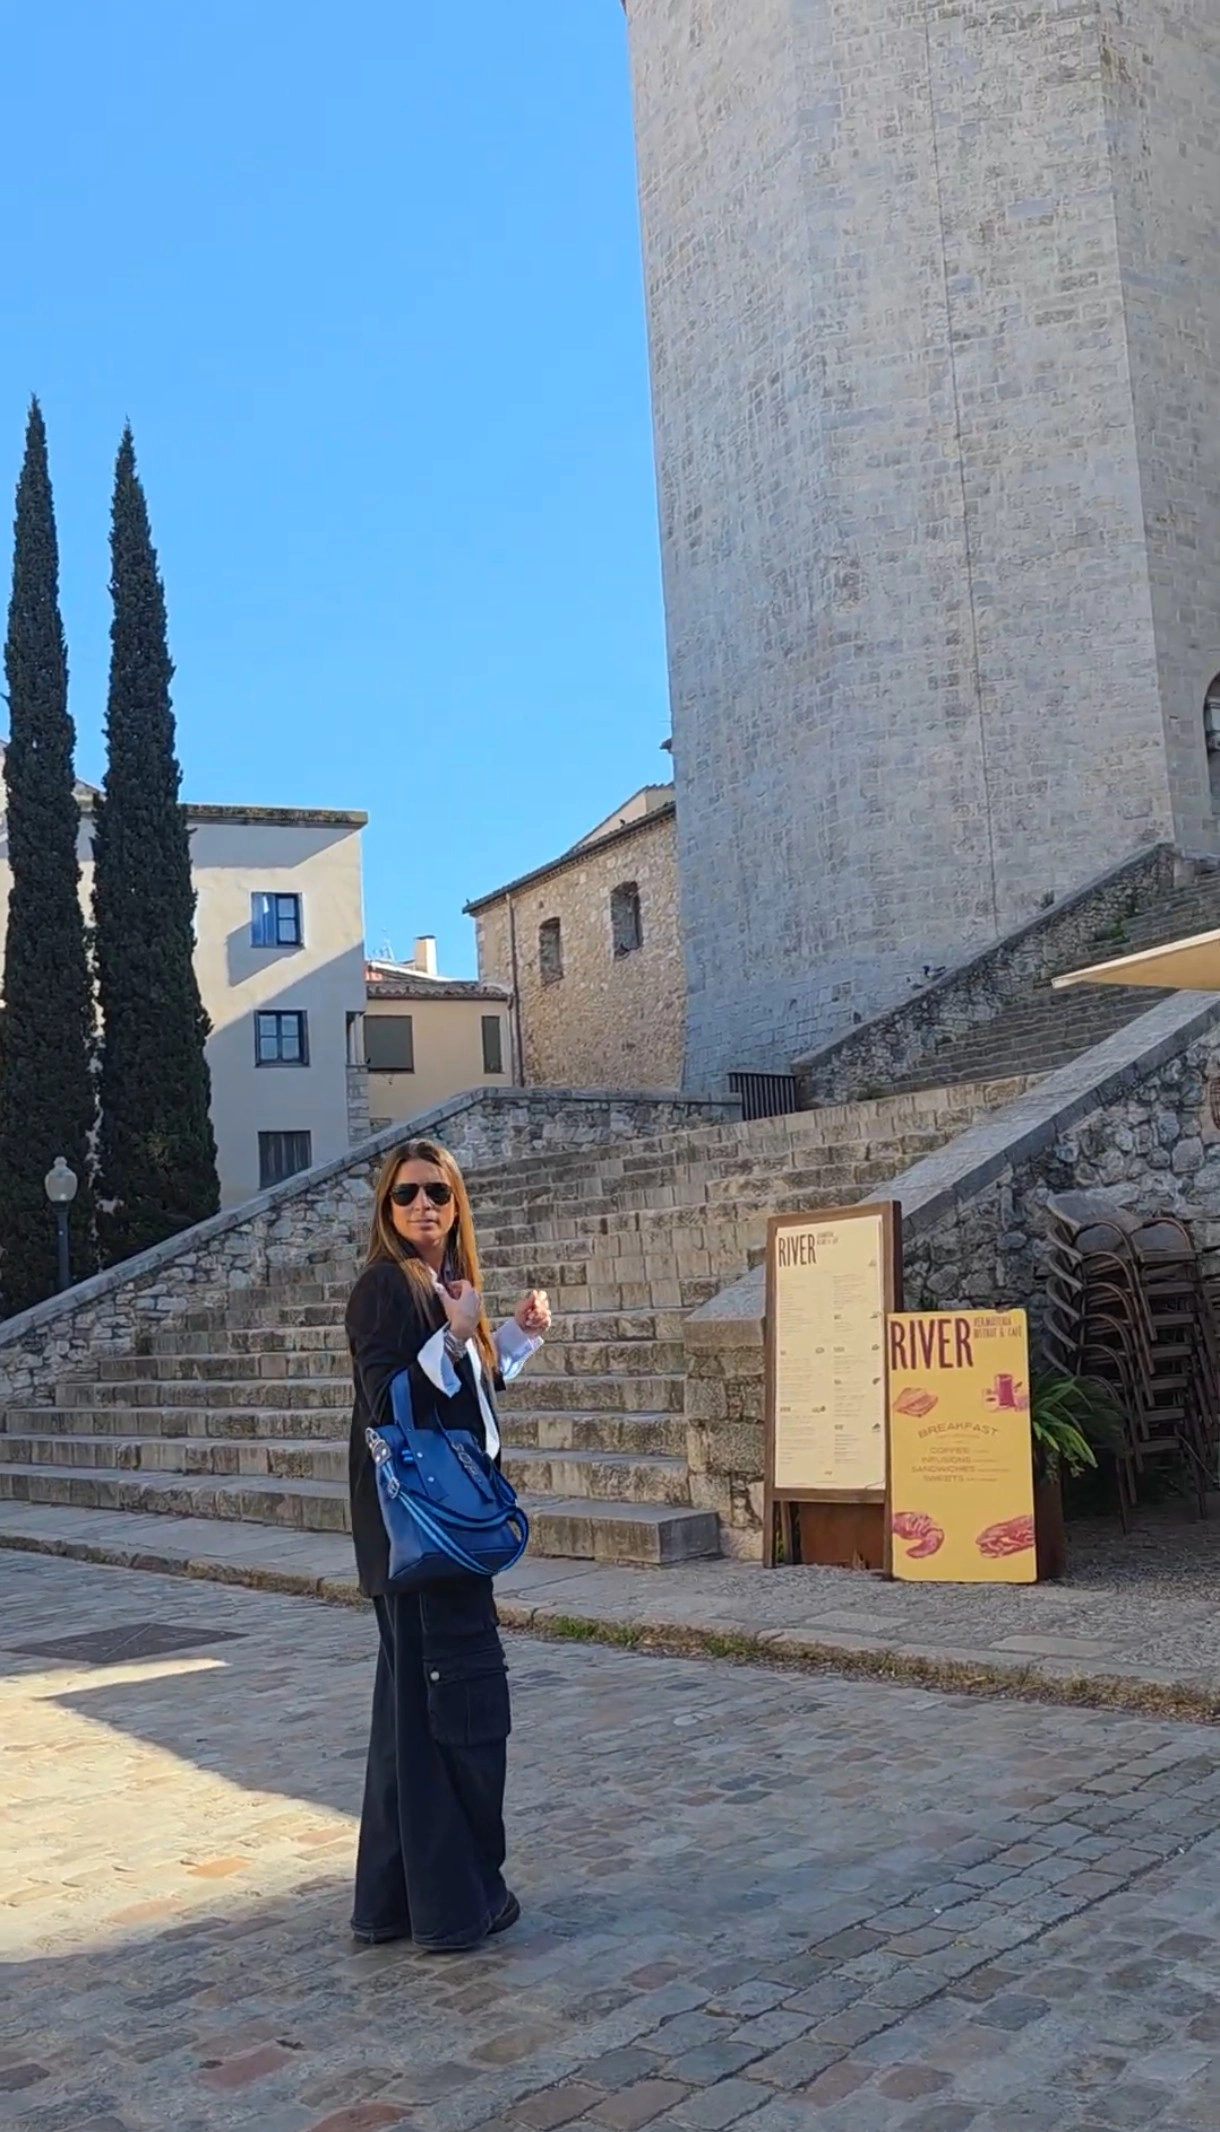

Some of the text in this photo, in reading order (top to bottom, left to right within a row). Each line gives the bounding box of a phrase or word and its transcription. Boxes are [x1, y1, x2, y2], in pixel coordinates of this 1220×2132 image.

[778, 1234, 816, 1267] RIVER
[890, 1318, 973, 1370] RIVER
[918, 1422, 998, 1438] BREAKFAST
